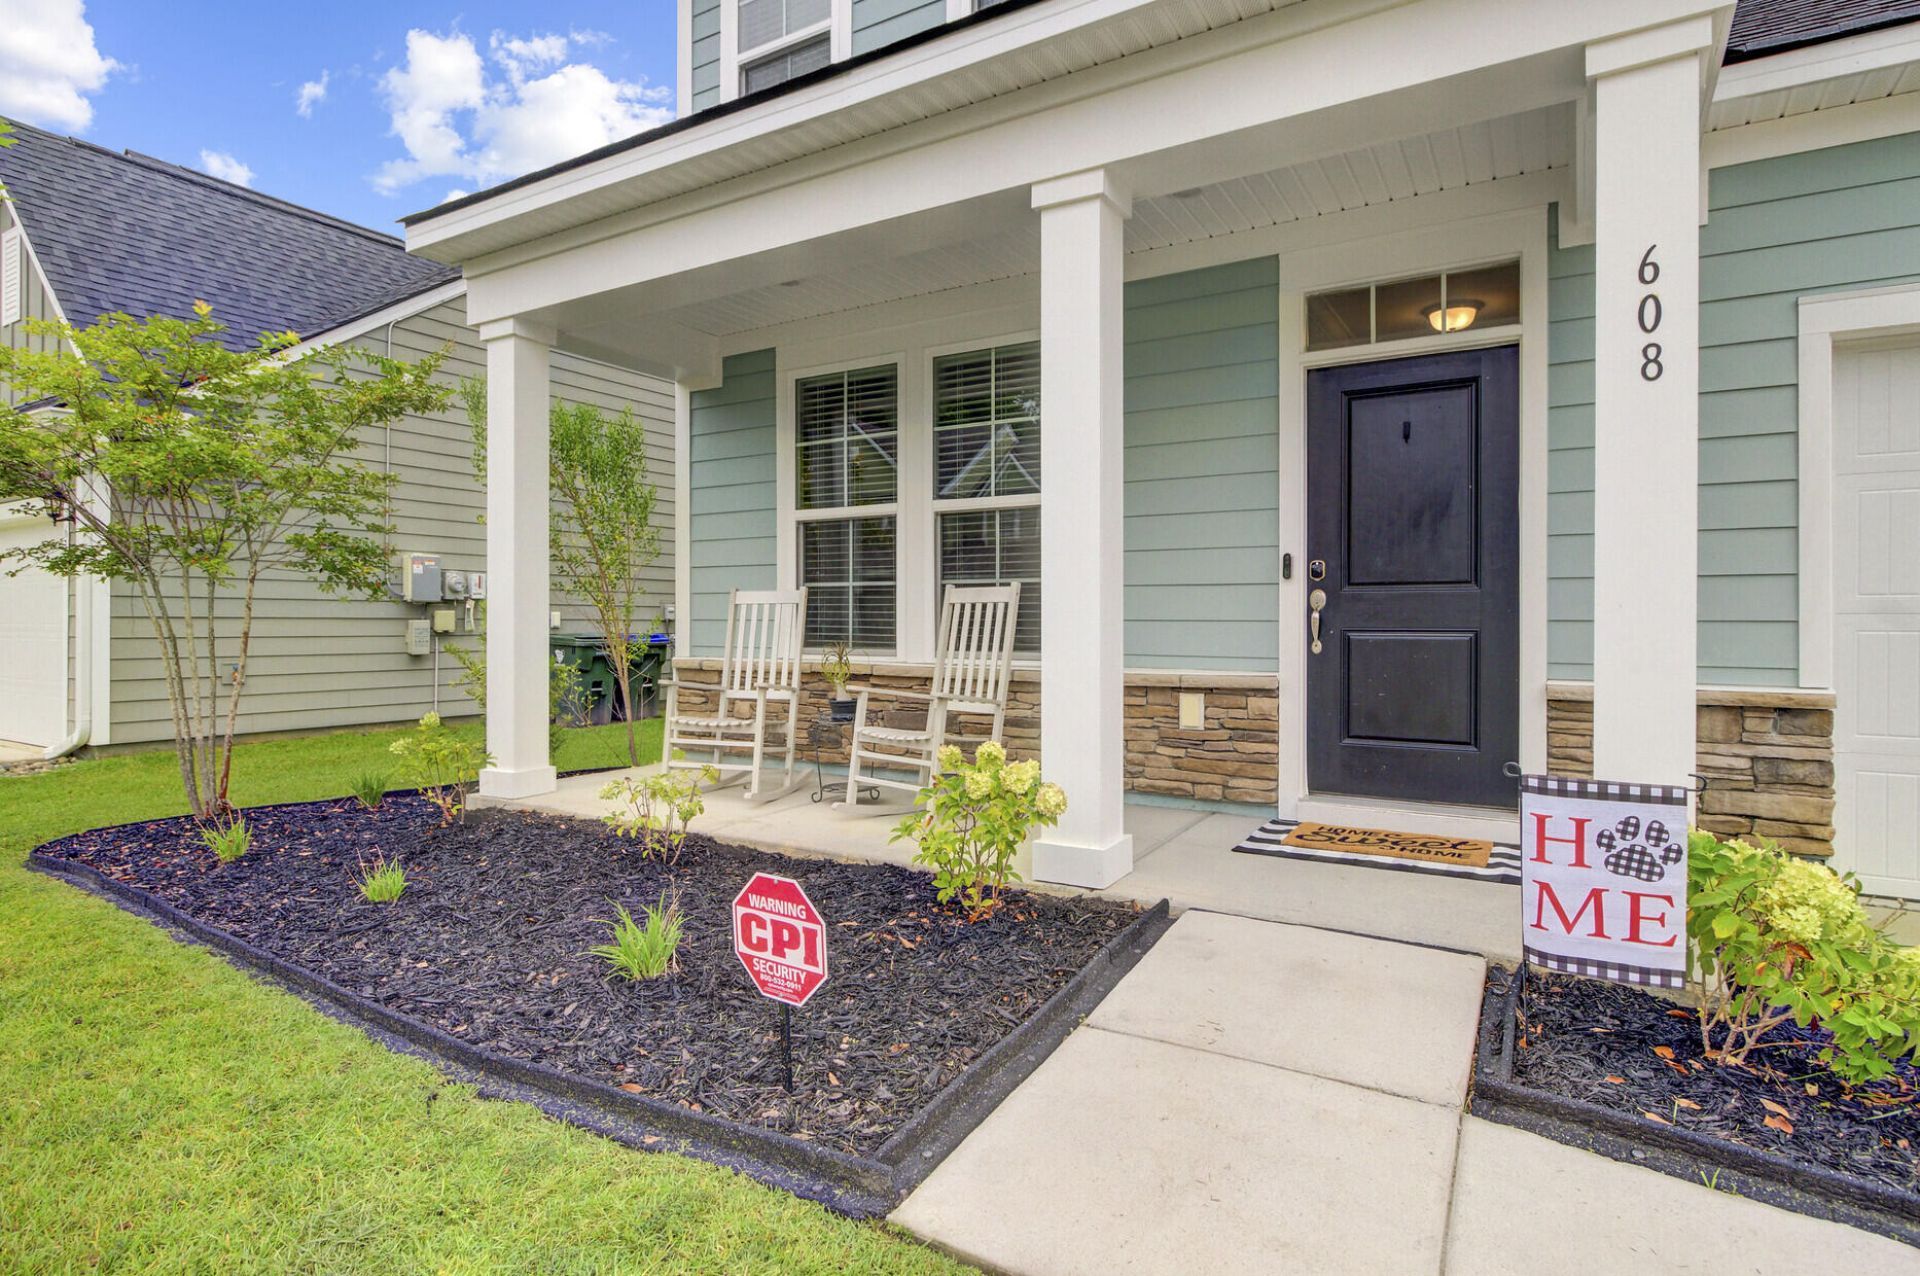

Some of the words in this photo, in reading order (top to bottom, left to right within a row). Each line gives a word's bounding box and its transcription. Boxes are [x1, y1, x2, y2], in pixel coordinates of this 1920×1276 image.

[1638, 244, 1663, 382] 608
[1295, 831, 1482, 851] Sweet
[1317, 826, 1380, 838] HOME
[1529, 812, 1593, 869] H
[1400, 847, 1471, 860] HOME
[748, 893, 806, 919] WARNING
[1529, 879, 1678, 948] ME
[740, 912, 820, 968] CPI
[753, 957, 807, 984] SECURITY
